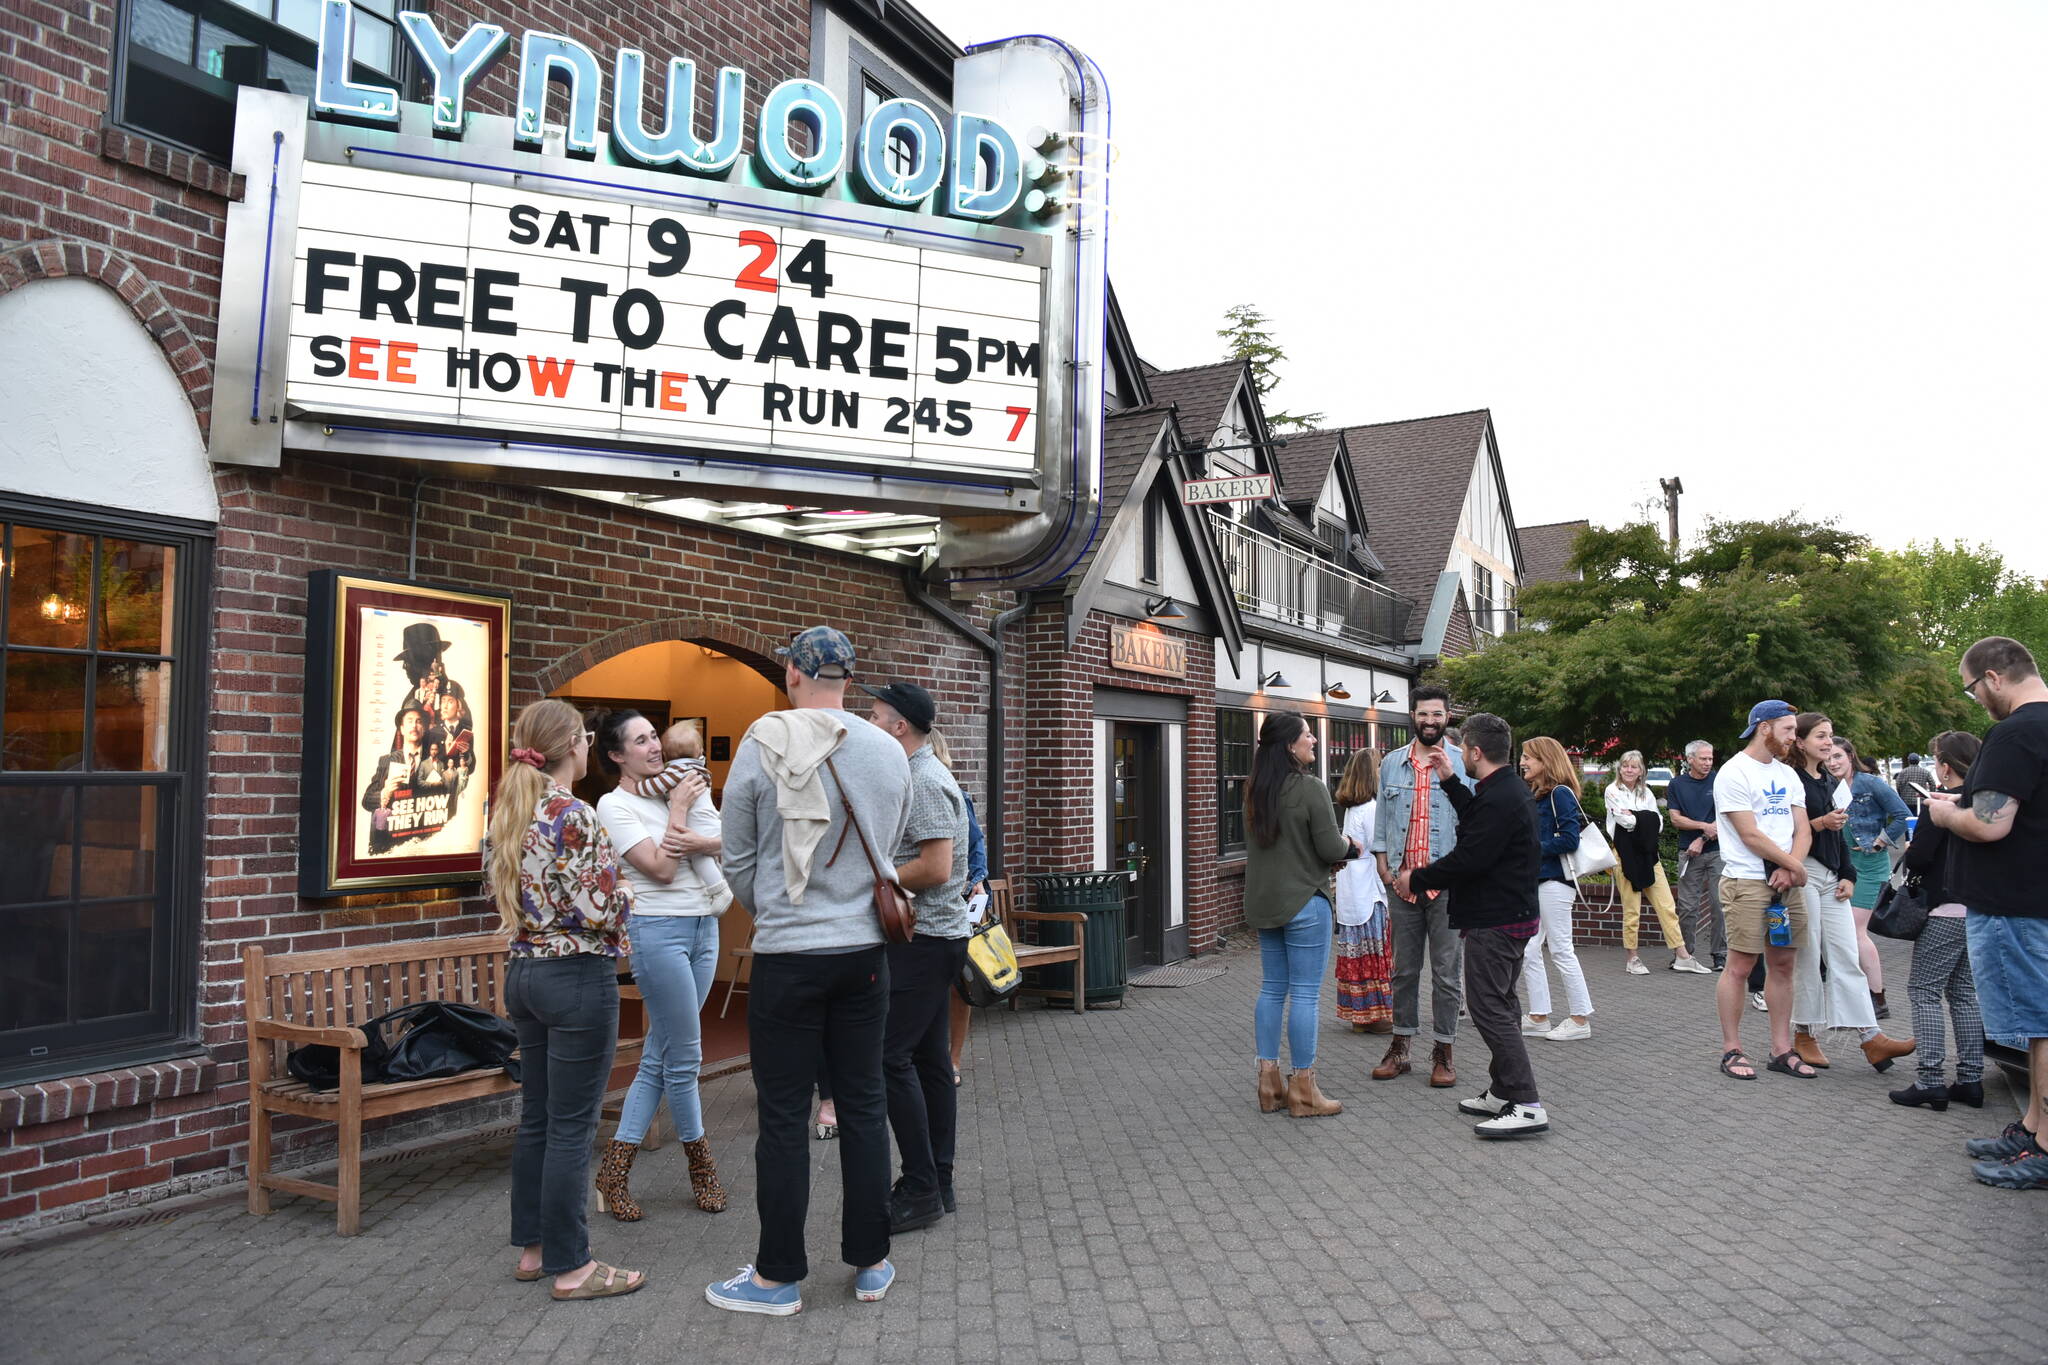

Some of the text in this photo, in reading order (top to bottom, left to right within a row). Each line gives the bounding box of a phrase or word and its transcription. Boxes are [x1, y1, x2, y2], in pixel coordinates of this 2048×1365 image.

[316, 0, 1024, 218] LYNWOOD
[508, 204, 610, 255] SAT
[647, 218, 691, 277] 9
[305, 248, 1040, 384] FREE TO CARE 5PM
[309, 335, 1031, 441] SEE HOW THEY RUN 245 7
[1188, 478, 1268, 501] BAKERY
[1113, 632, 1184, 672] BAKERY
[387, 808, 448, 831] THEY RUN
[391, 798, 415, 816] SEE
[415, 793, 450, 812] HOW
